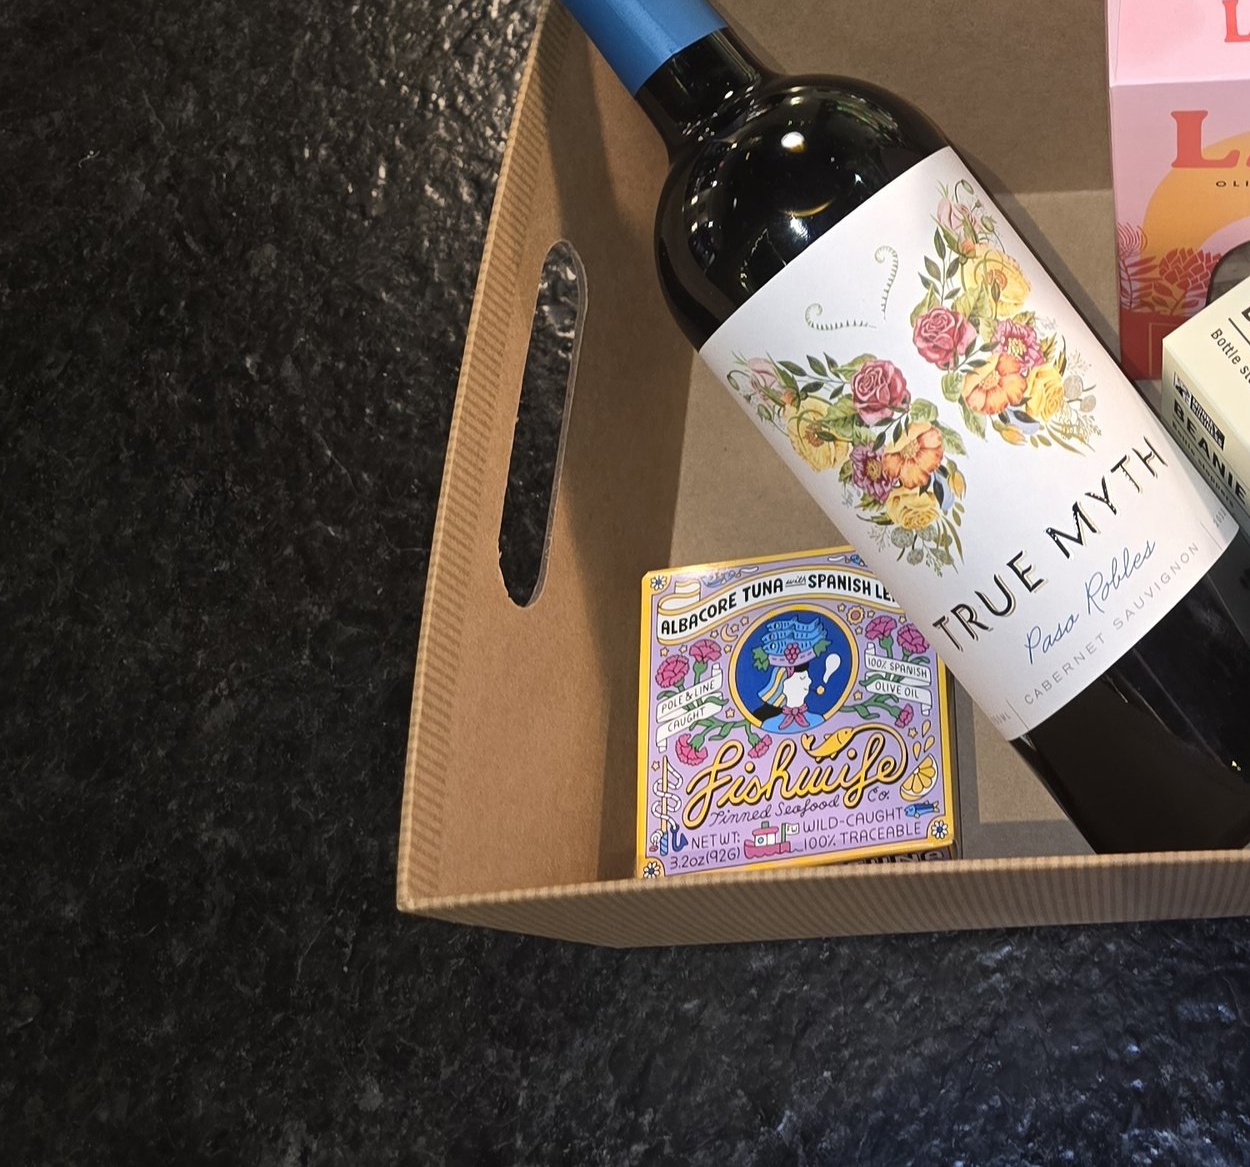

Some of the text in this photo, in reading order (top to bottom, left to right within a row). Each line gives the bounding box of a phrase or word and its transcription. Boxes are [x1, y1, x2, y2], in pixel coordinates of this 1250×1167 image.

[1210, 328, 1242, 365] Bottle
[1174, 399, 1247, 505] BEANIE
[932, 436, 1168, 651] TRUE MYTH
[661, 592, 737, 635] ALBACORE
[742, 578, 783, 602] TUNA
[785, 575, 807, 587] with
[808, 574, 871, 596] SPANISH
[1024, 540, 1155, 664] Paso Robles
[1024, 542, 1199, 705] CABERNET SAUVIGNON
[868, 657, 927, 678] 100% SPANISH
[661, 680, 715, 714] POLE & LINE
[875, 681, 919, 699] OLIVE OIL
[668, 706, 705, 732] CAUGHT
[682, 726, 907, 830] Fishwife
[709, 786, 890, 827] Tinned Seafood Co.
[803, 807, 903, 833] WILD-CAUGHT
[691, 834, 717, 849] NET
[803, 821, 921, 851] 100% TRACEABLE
